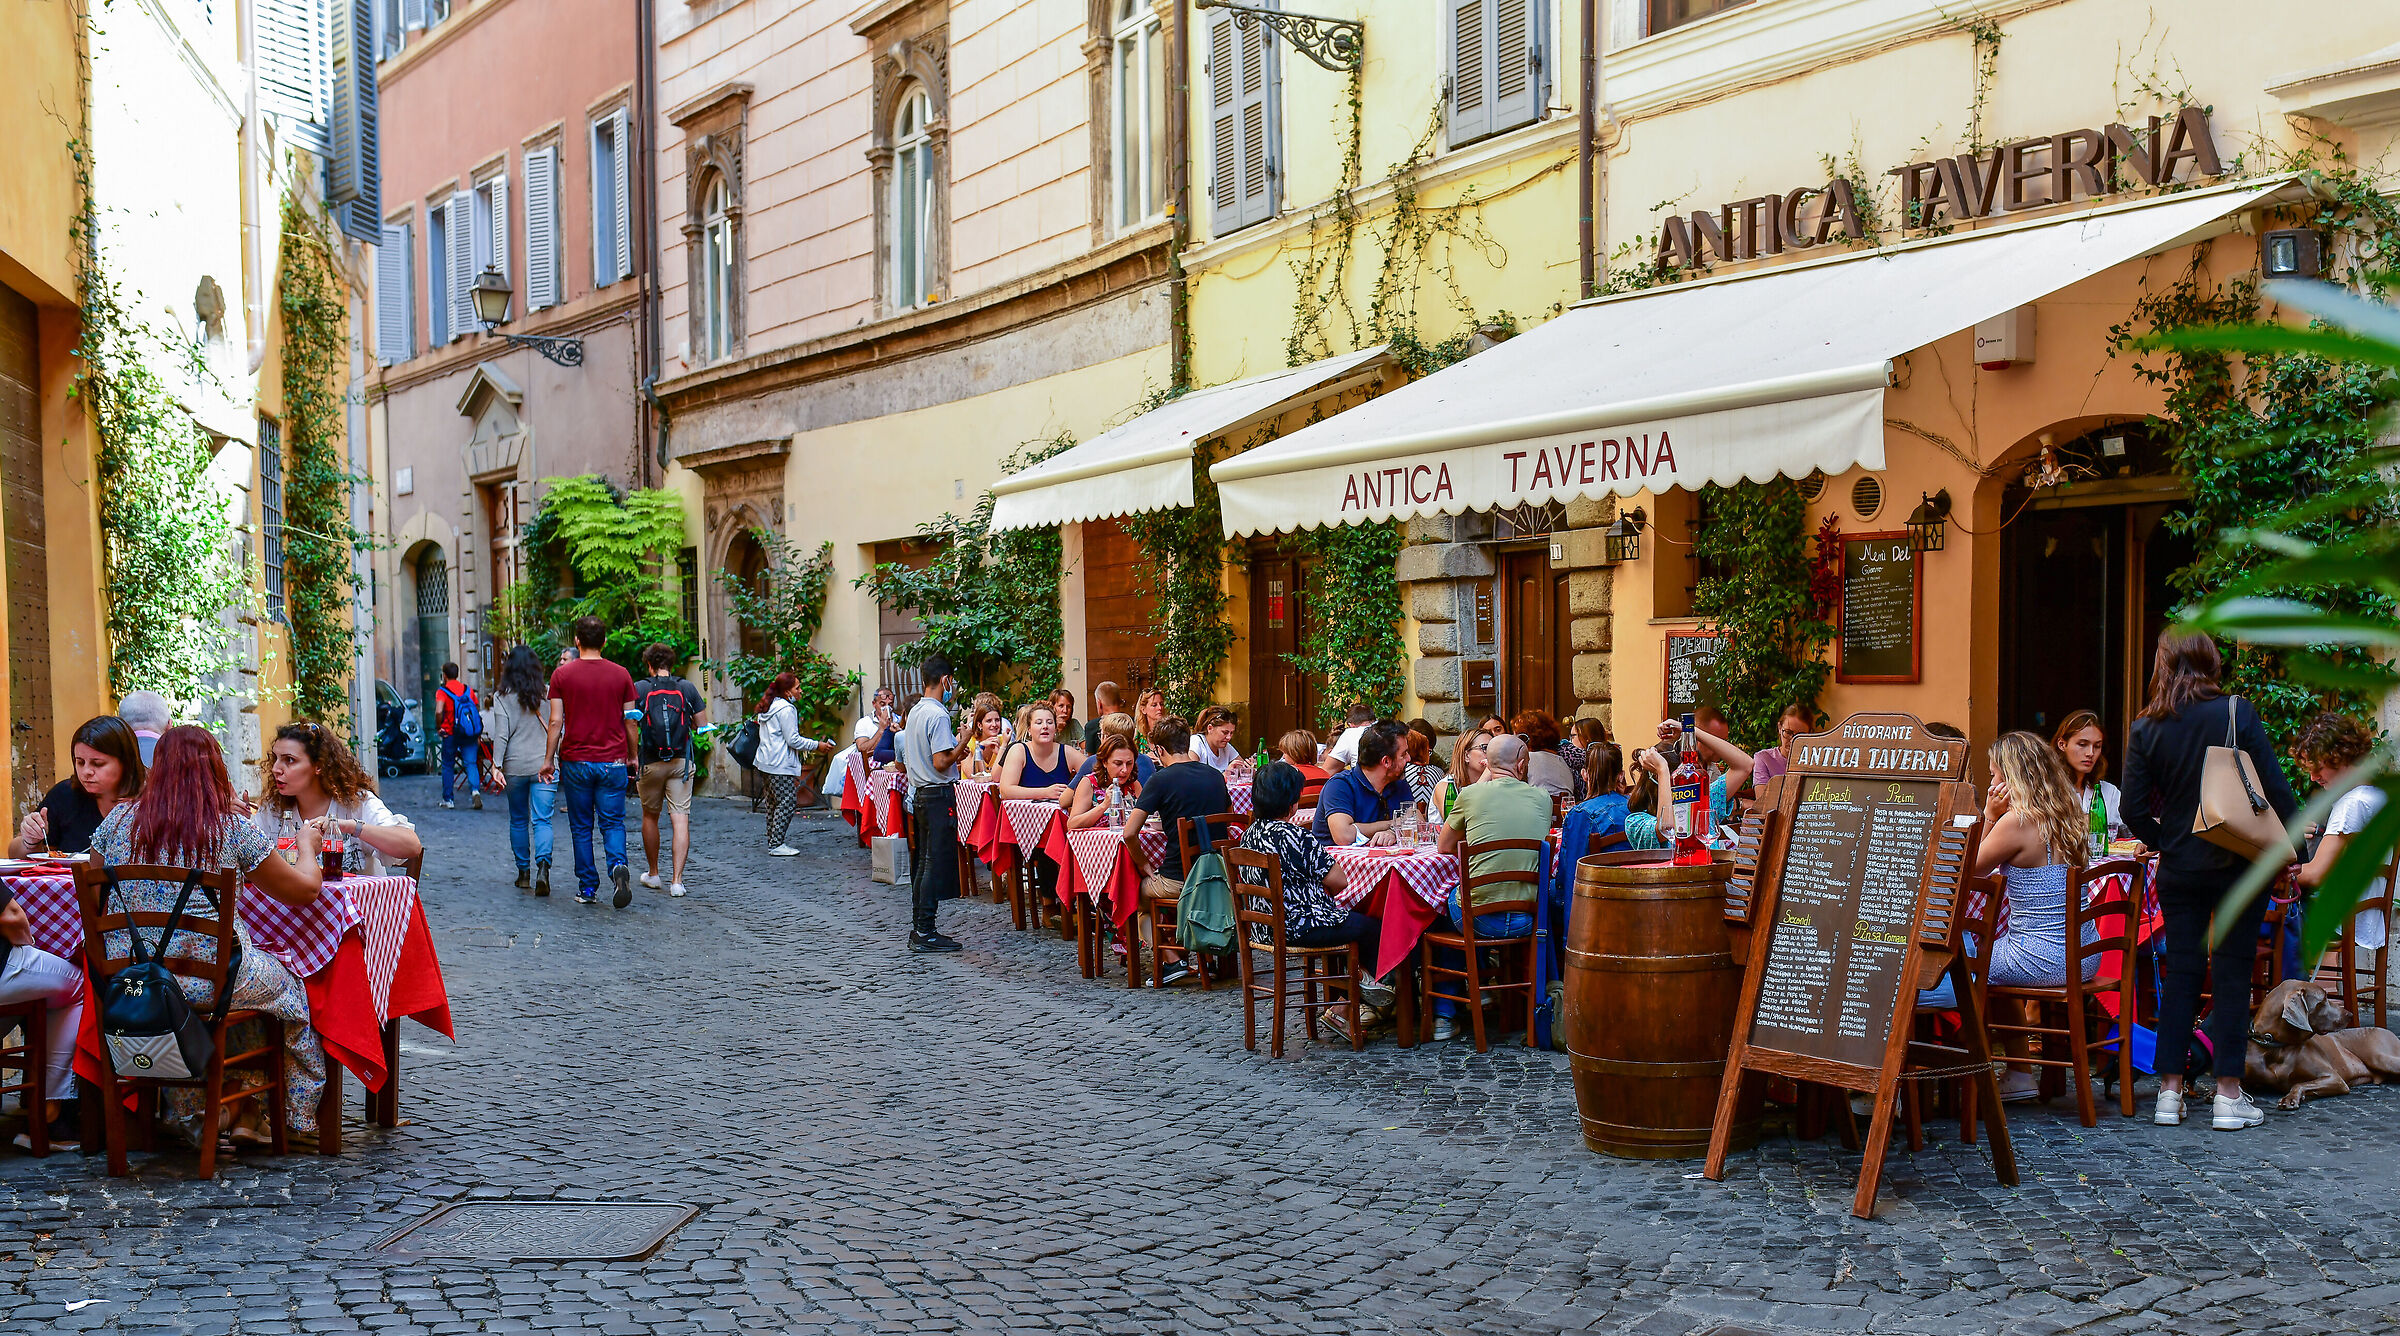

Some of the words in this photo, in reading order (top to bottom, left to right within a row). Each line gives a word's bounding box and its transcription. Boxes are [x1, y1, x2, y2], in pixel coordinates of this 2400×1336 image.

[1655, 178, 1864, 277] ANTICA
[1888, 107, 2222, 229] TAVERNA
[1341, 462, 1454, 511] ANTICA
[1503, 431, 1677, 492] TAVERNA
[1551, 546, 1560, 559] 11
[1892, 546, 1911, 562] Del
[1798, 746, 1859, 768] ANTICA
[1869, 748, 1948, 771] TAVERNA
[1672, 790, 1696, 801] PEROL
[1808, 782, 1851, 806] Antipasti
[1886, 783, 1914, 804] Primi
[1853, 920, 1881, 941] Pinsa
[1884, 933, 1906, 944] romana
